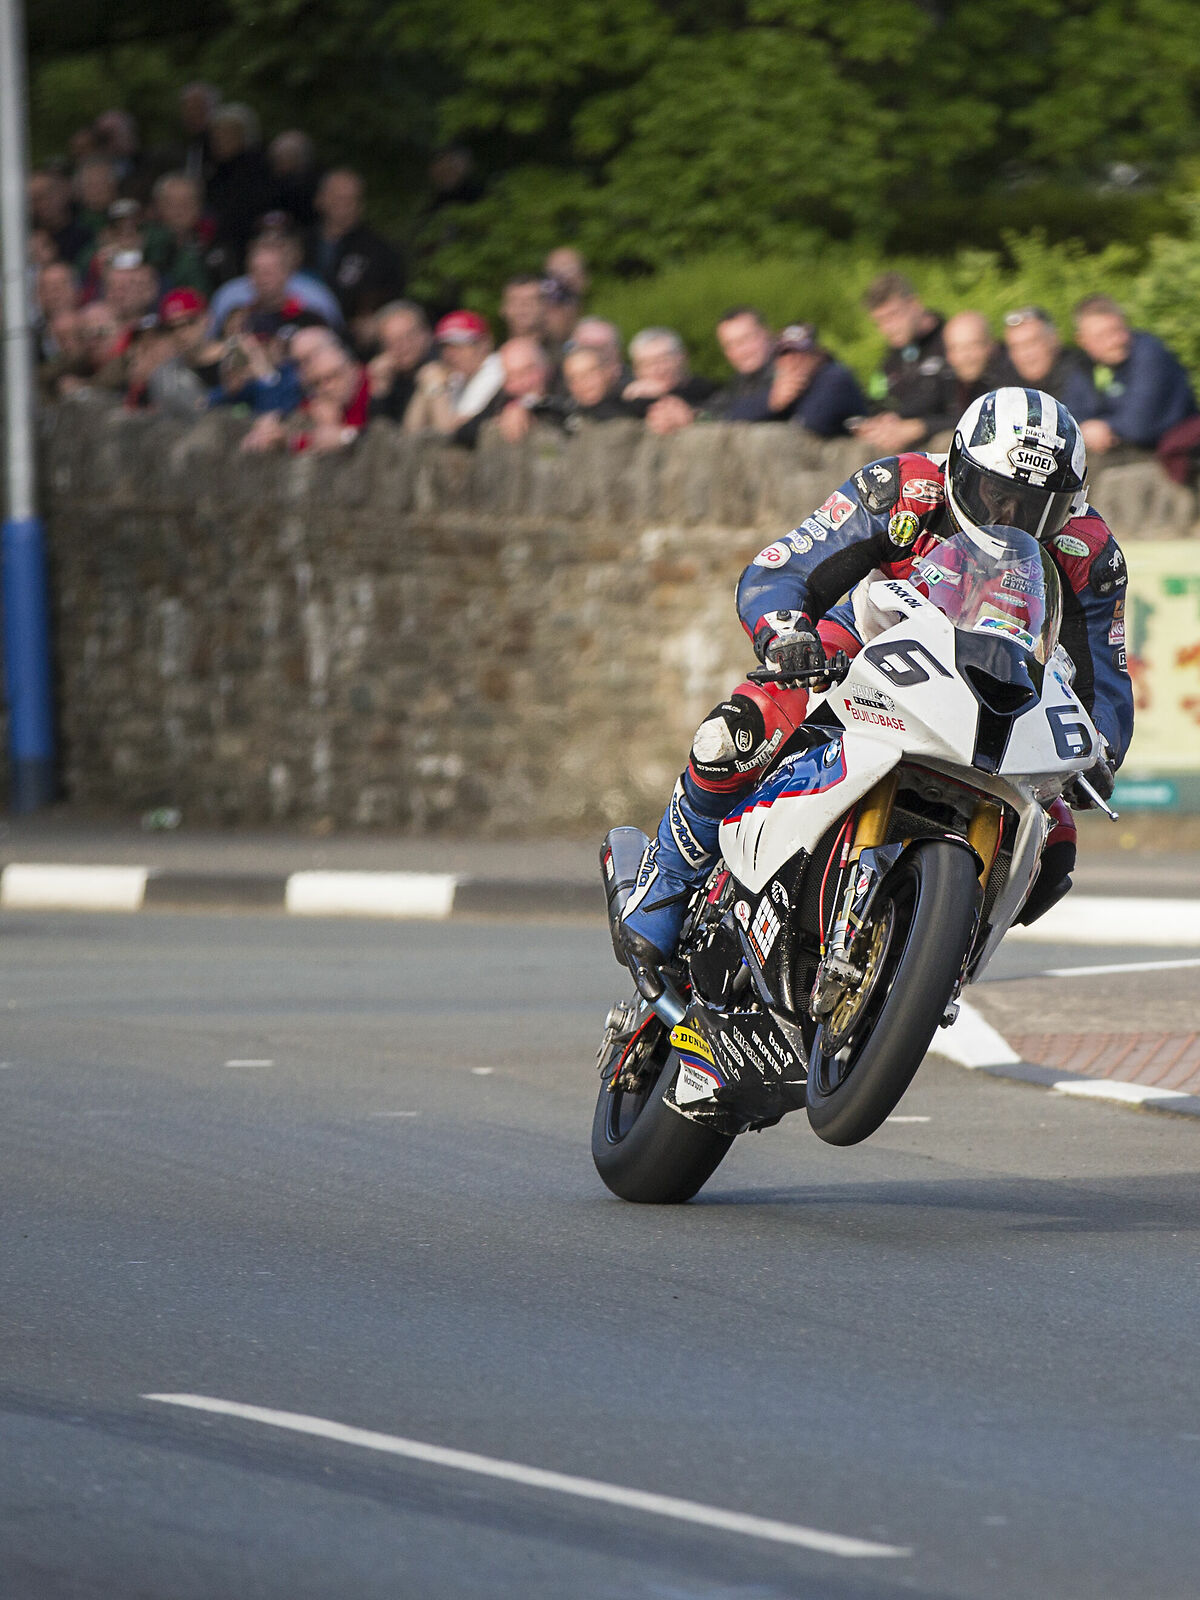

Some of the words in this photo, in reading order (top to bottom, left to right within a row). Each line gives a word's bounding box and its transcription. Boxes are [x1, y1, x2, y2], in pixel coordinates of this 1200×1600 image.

[1016, 450, 1052, 471] SHOEI
[883, 580, 912, 599] ROCK
[903, 597, 923, 609] OIL
[863, 639, 955, 688] 6
[851, 707, 906, 731] BUILDBASE
[1045, 704, 1093, 761] 6
